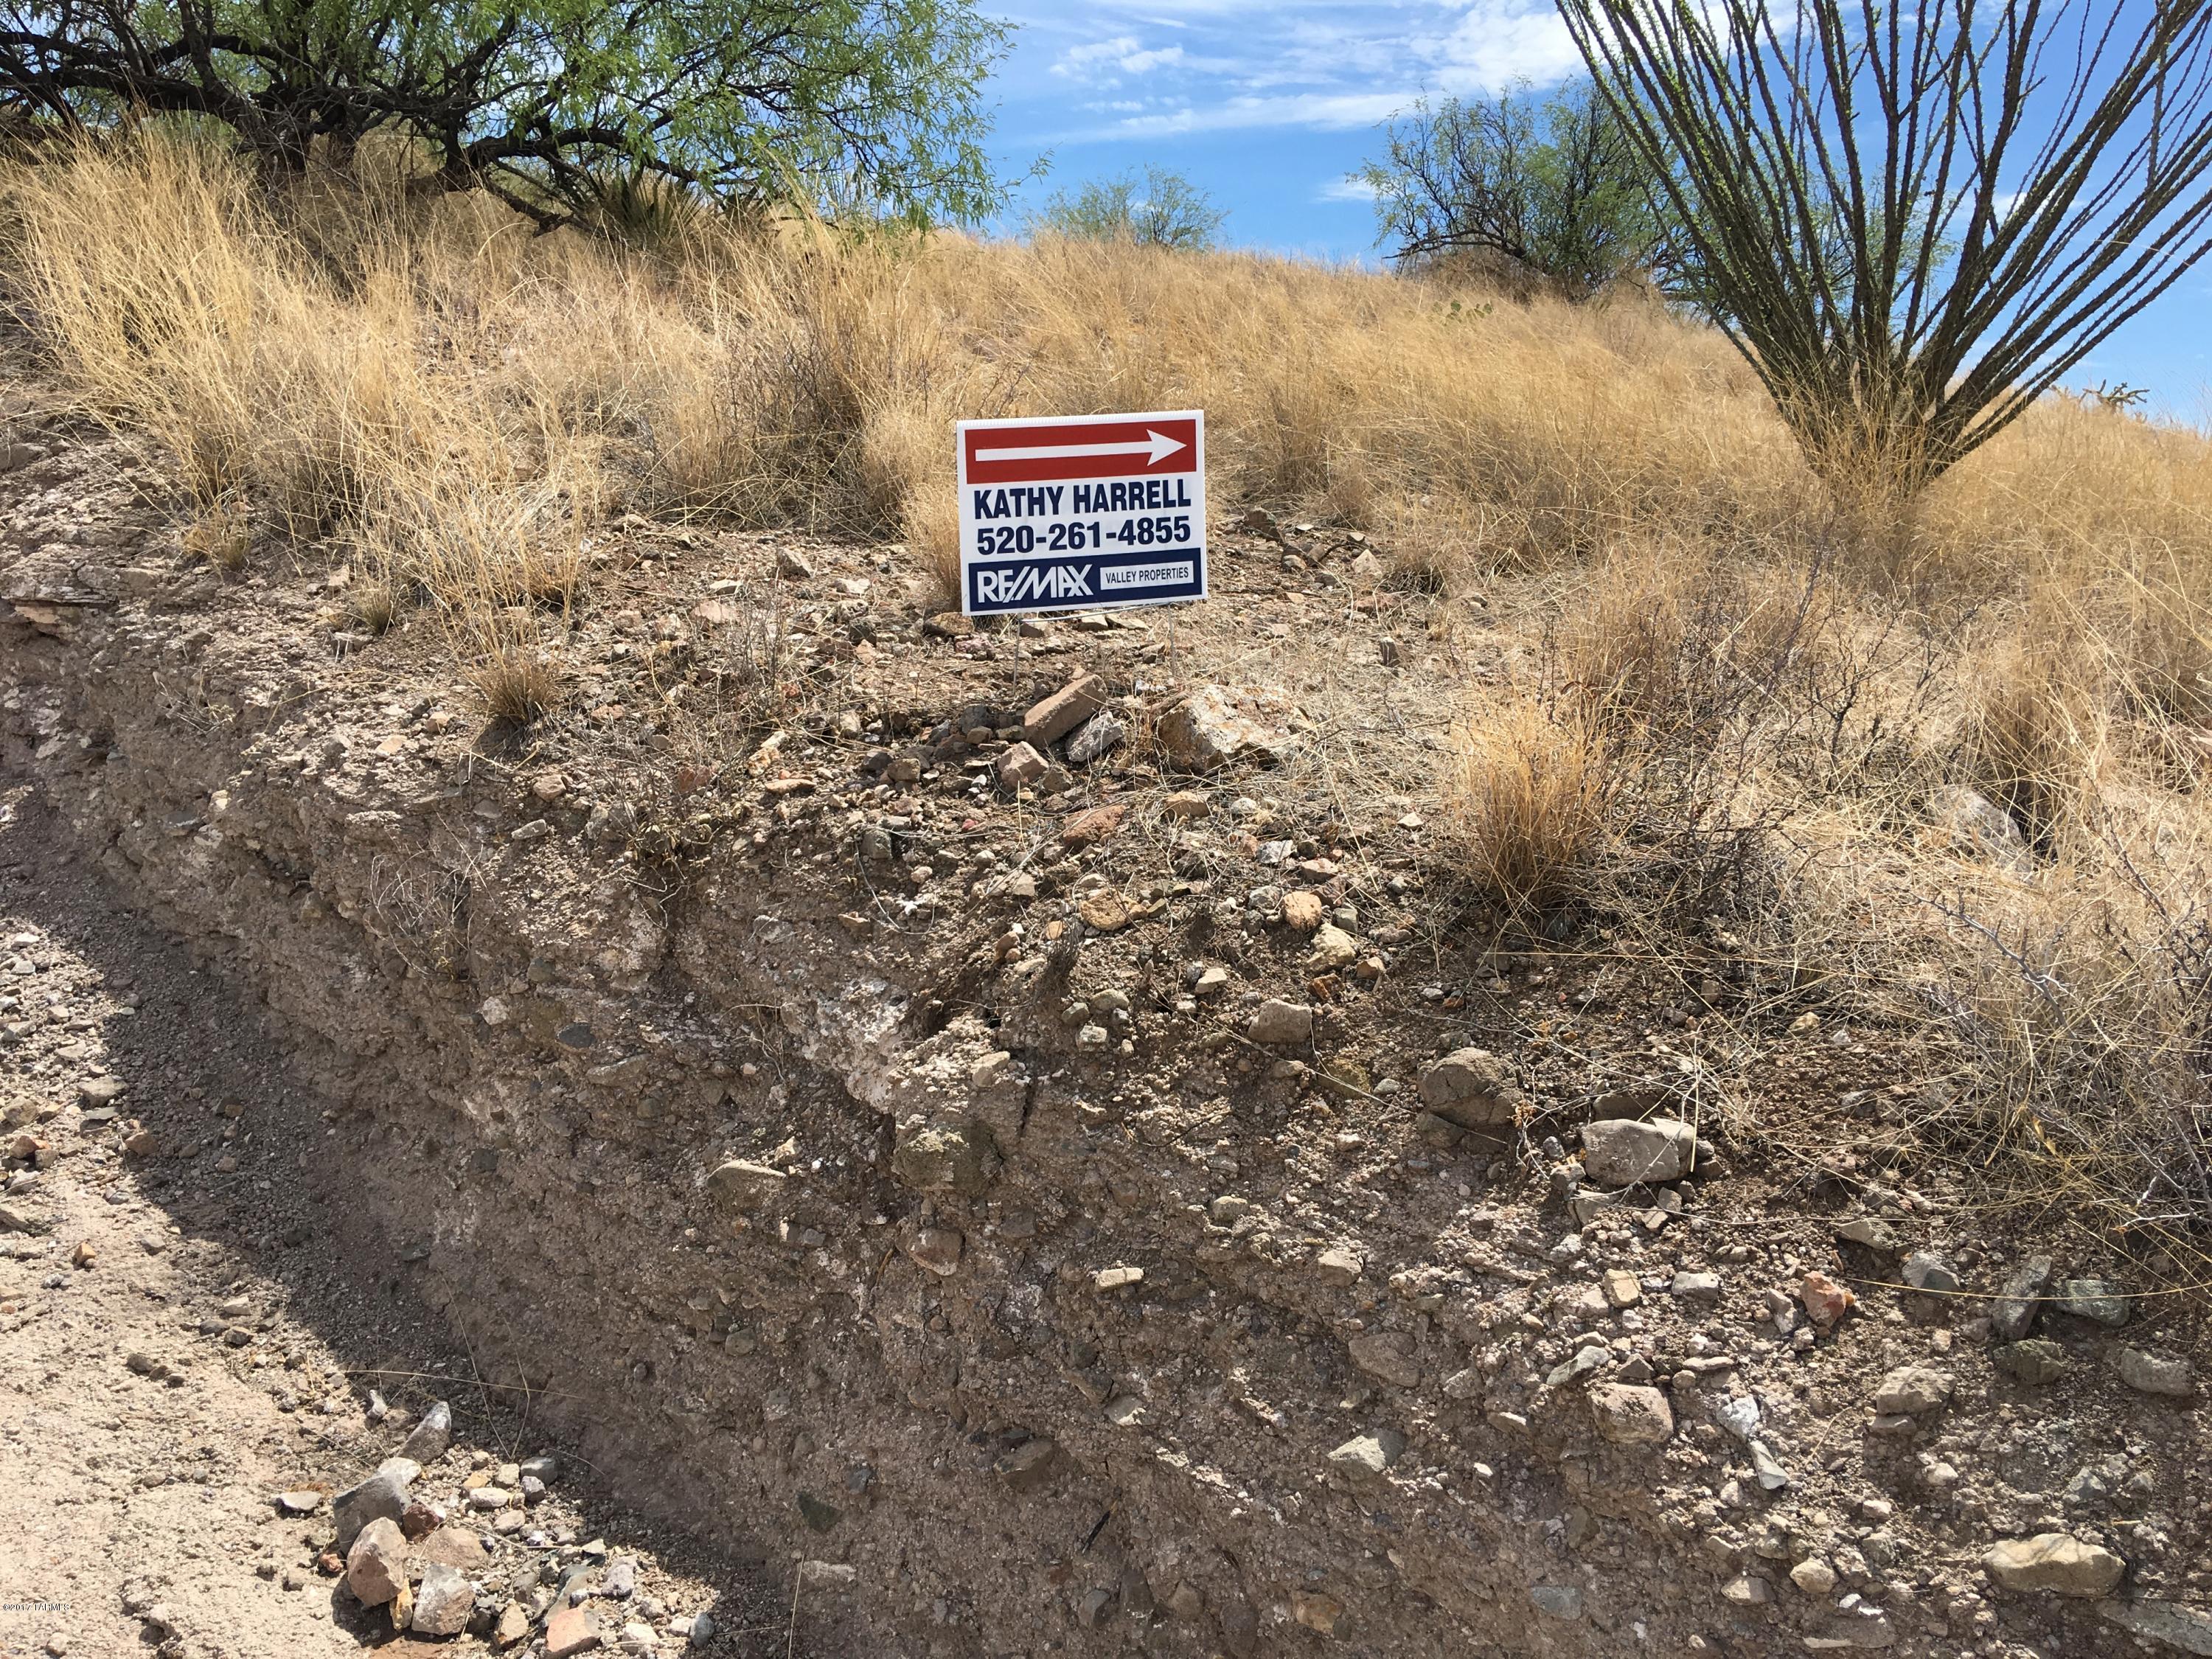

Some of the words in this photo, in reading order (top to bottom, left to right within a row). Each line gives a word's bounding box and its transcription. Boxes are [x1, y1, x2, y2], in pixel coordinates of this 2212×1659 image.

[974, 486, 1064, 519] KATHY
[1073, 479, 1191, 514] HARRELL
[977, 515, 1191, 555] 520-261-4855
[977, 564, 1093, 603] RE/MAX
[1105, 569, 1137, 583] VALLEY
[1139, 567, 1189, 581] PROPERTIES
